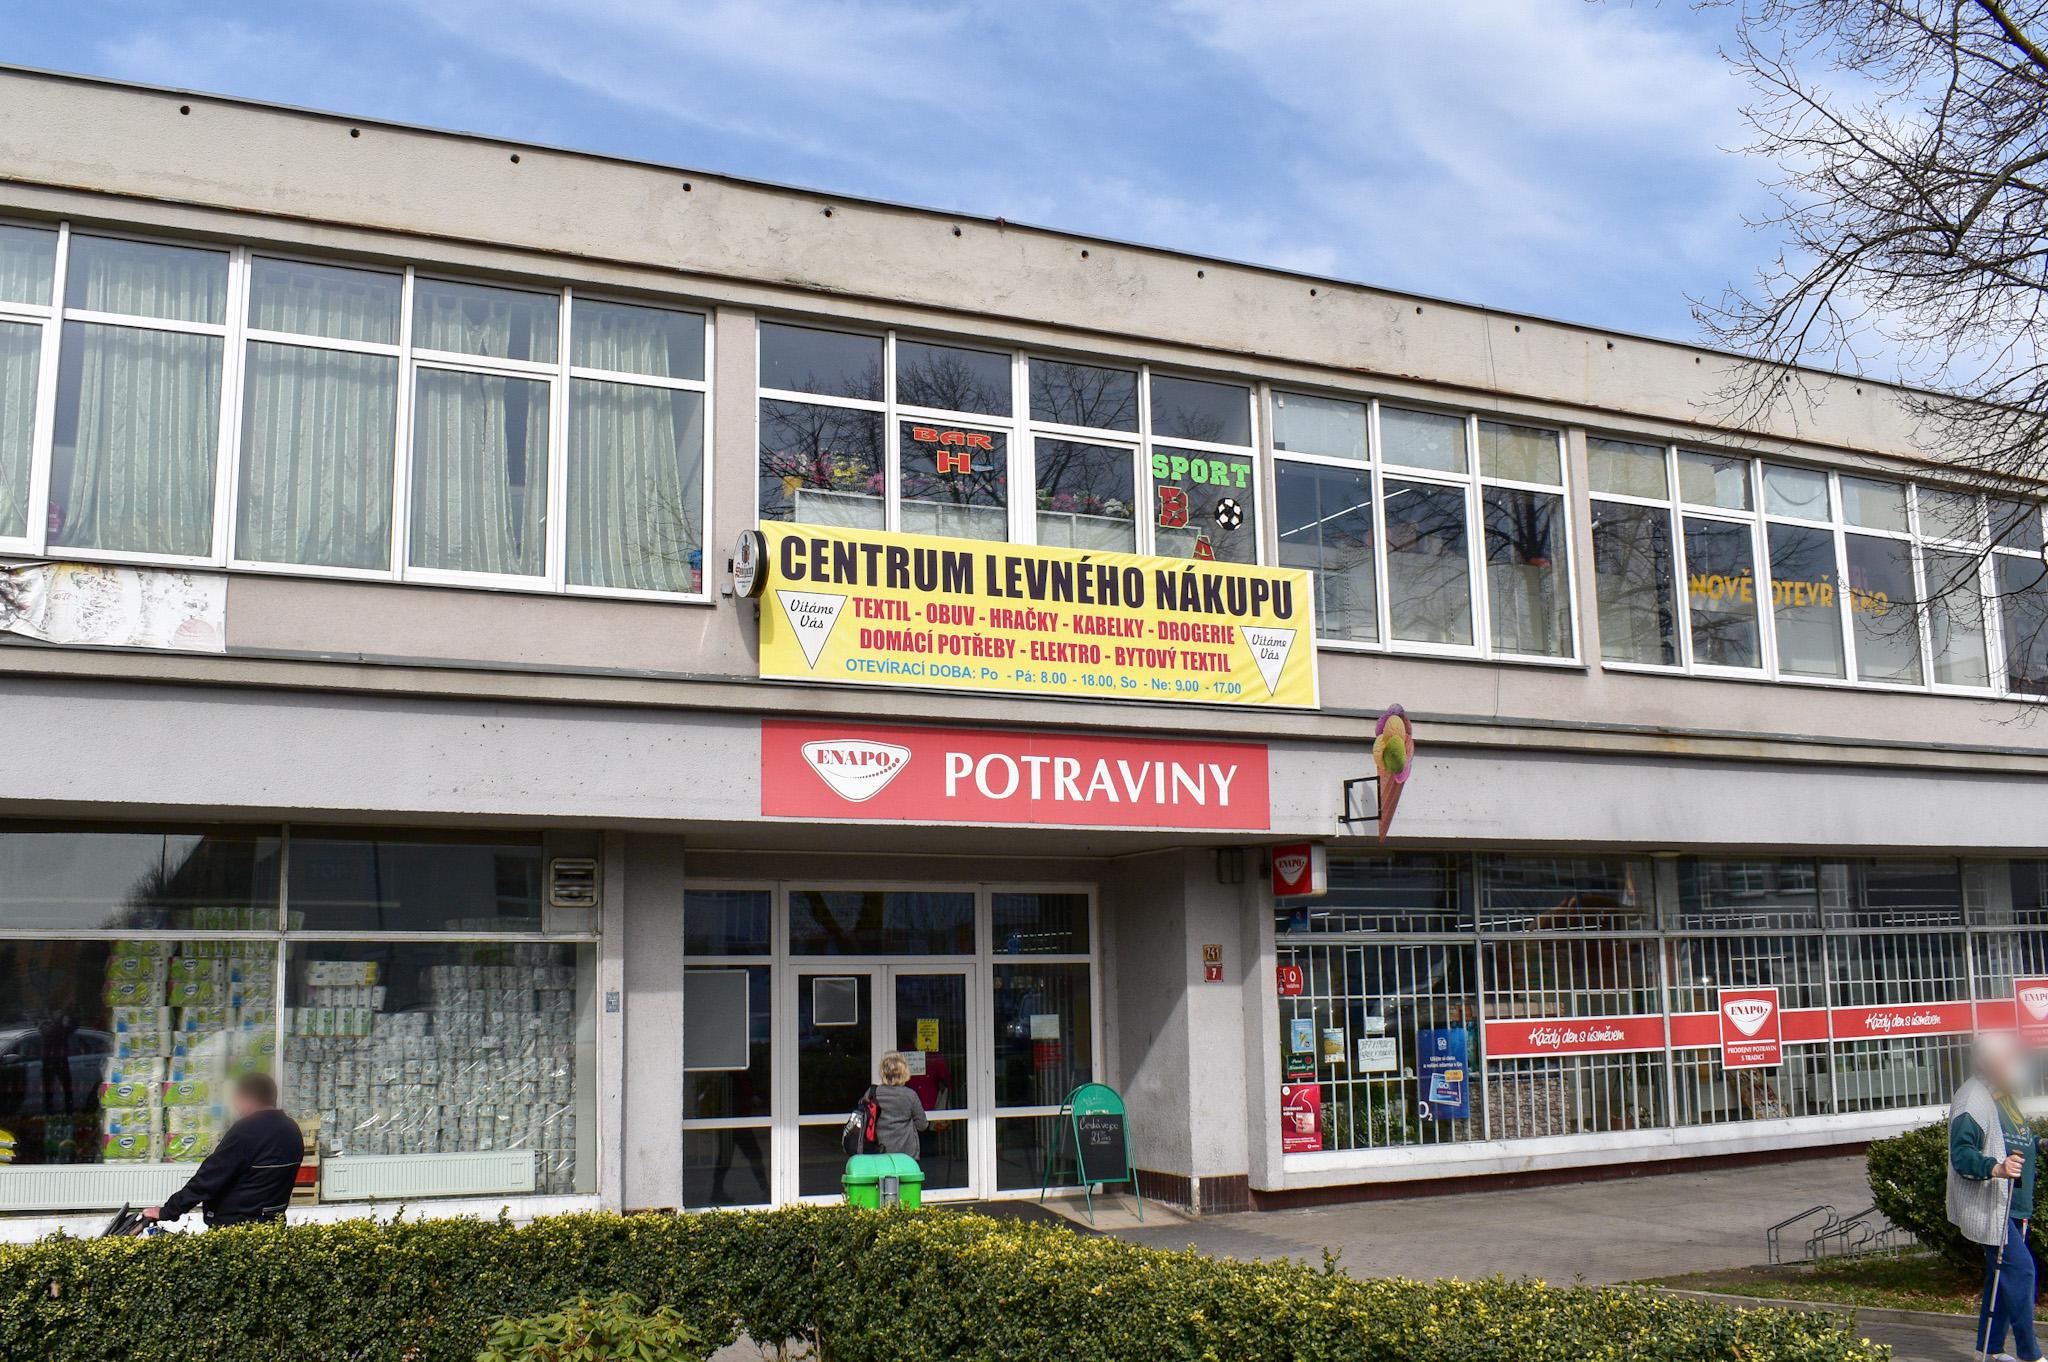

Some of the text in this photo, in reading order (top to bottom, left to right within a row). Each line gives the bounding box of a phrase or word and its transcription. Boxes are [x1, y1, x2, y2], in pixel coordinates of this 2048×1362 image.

[912, 427, 993, 450] BAR
[1152, 454, 1250, 489] SPORT
[780, 535, 1293, 620] CENTRUM LEVNÉHO NÁKUPU
[800, 614, 824, 629] Vás
[853, 597, 911, 622] TEXTIL
[926, 602, 975, 627] OBUV
[990, 606, 1059, 632] HRAČKY
[1073, 614, 1144, 639] KABELKY
[1158, 621, 1235, 645] DROGERIE
[860, 627, 933, 654] DOMÁCÍ
[938, 632, 1016, 660] POTŘEBY
[1030, 640, 1100, 665] ELEKTRO
[1115, 645, 1176, 670] BYTOVÝ
[1180, 651, 1232, 673] TEXTIL
[1261, 648, 1280, 661] Vás
[846, 657, 925, 676] OTEVÍRACÍ
[930, 664, 976, 680] DOBA:
[981, 667, 998, 681] Po
[1016, 668, 1036, 683] Pá:
[1041, 671, 1067, 685] 8.00
[1081, 674, 1117, 689] 18.00,
[1121, 676, 1137, 689] So
[1151, 678, 1172, 691] Ne:
[1175, 679, 1199, 692] 9.00
[1213, 682, 1241, 695] 17.00
[816, 749, 891, 767] ENAPO
[945, 751, 1237, 806] POTRAVINY
[1211, 967, 1217, 979] 7
[1730, 1005, 1764, 1016] ENAPO
[1864, 1011, 1941, 1033] Každý den s úsměvem
[1528, 1025, 1625, 1049] Každý den s úsměvem
[1727, 1046, 1752, 1054] PRODEJNY
